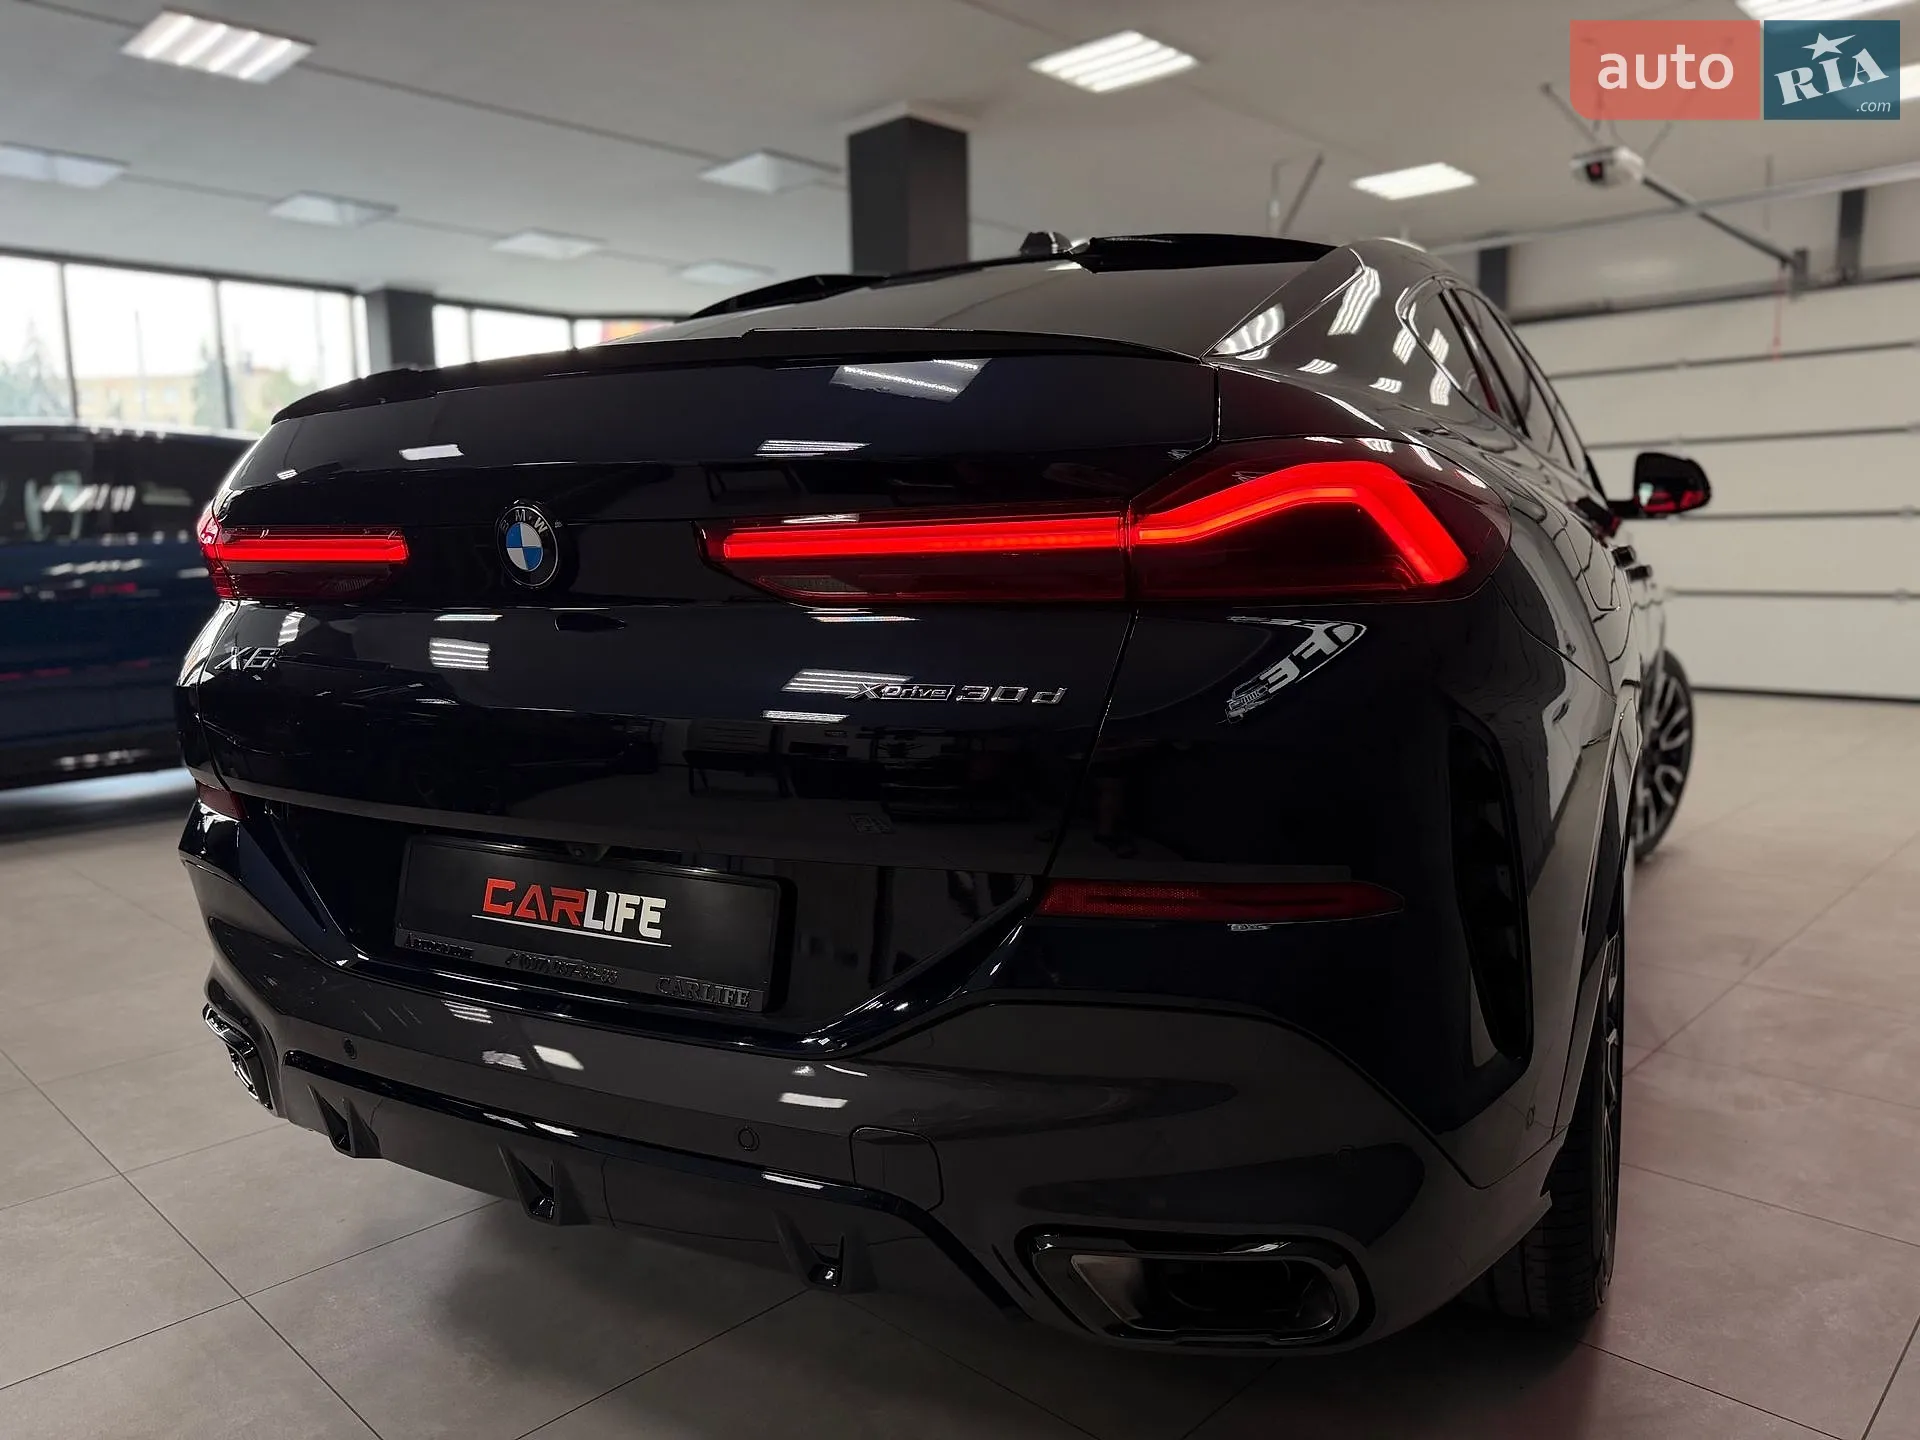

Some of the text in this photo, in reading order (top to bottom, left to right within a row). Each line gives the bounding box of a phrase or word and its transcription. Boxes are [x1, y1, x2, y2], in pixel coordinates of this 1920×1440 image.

[500, 508, 549, 535] BMW
[214, 646, 280, 671] X6
[483, 877, 667, 939] CARLIFE
[655, 976, 752, 1009] CARLIFE
